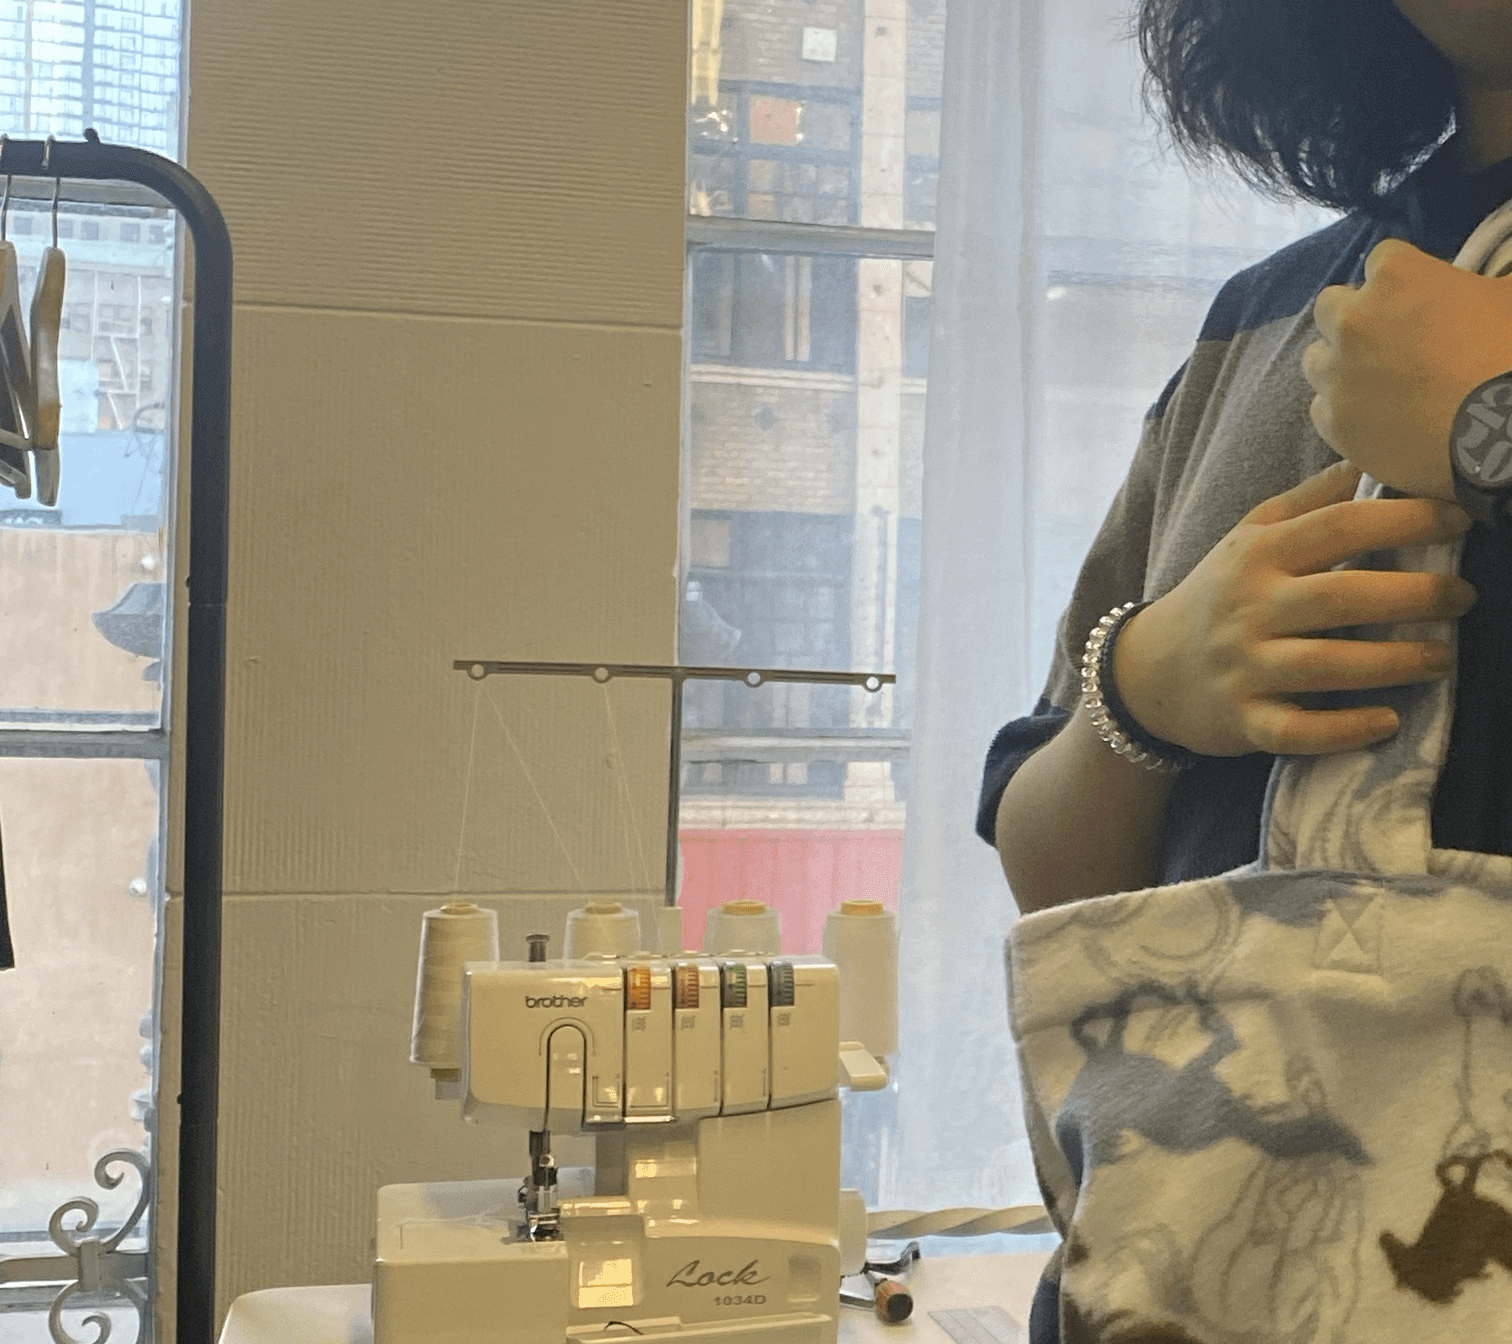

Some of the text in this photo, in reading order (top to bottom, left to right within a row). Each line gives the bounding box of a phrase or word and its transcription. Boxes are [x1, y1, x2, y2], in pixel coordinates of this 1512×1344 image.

[525, 995, 588, 1008] brother
[665, 1259, 772, 1288] Lock
[714, 1295, 766, 1306] 1034D
